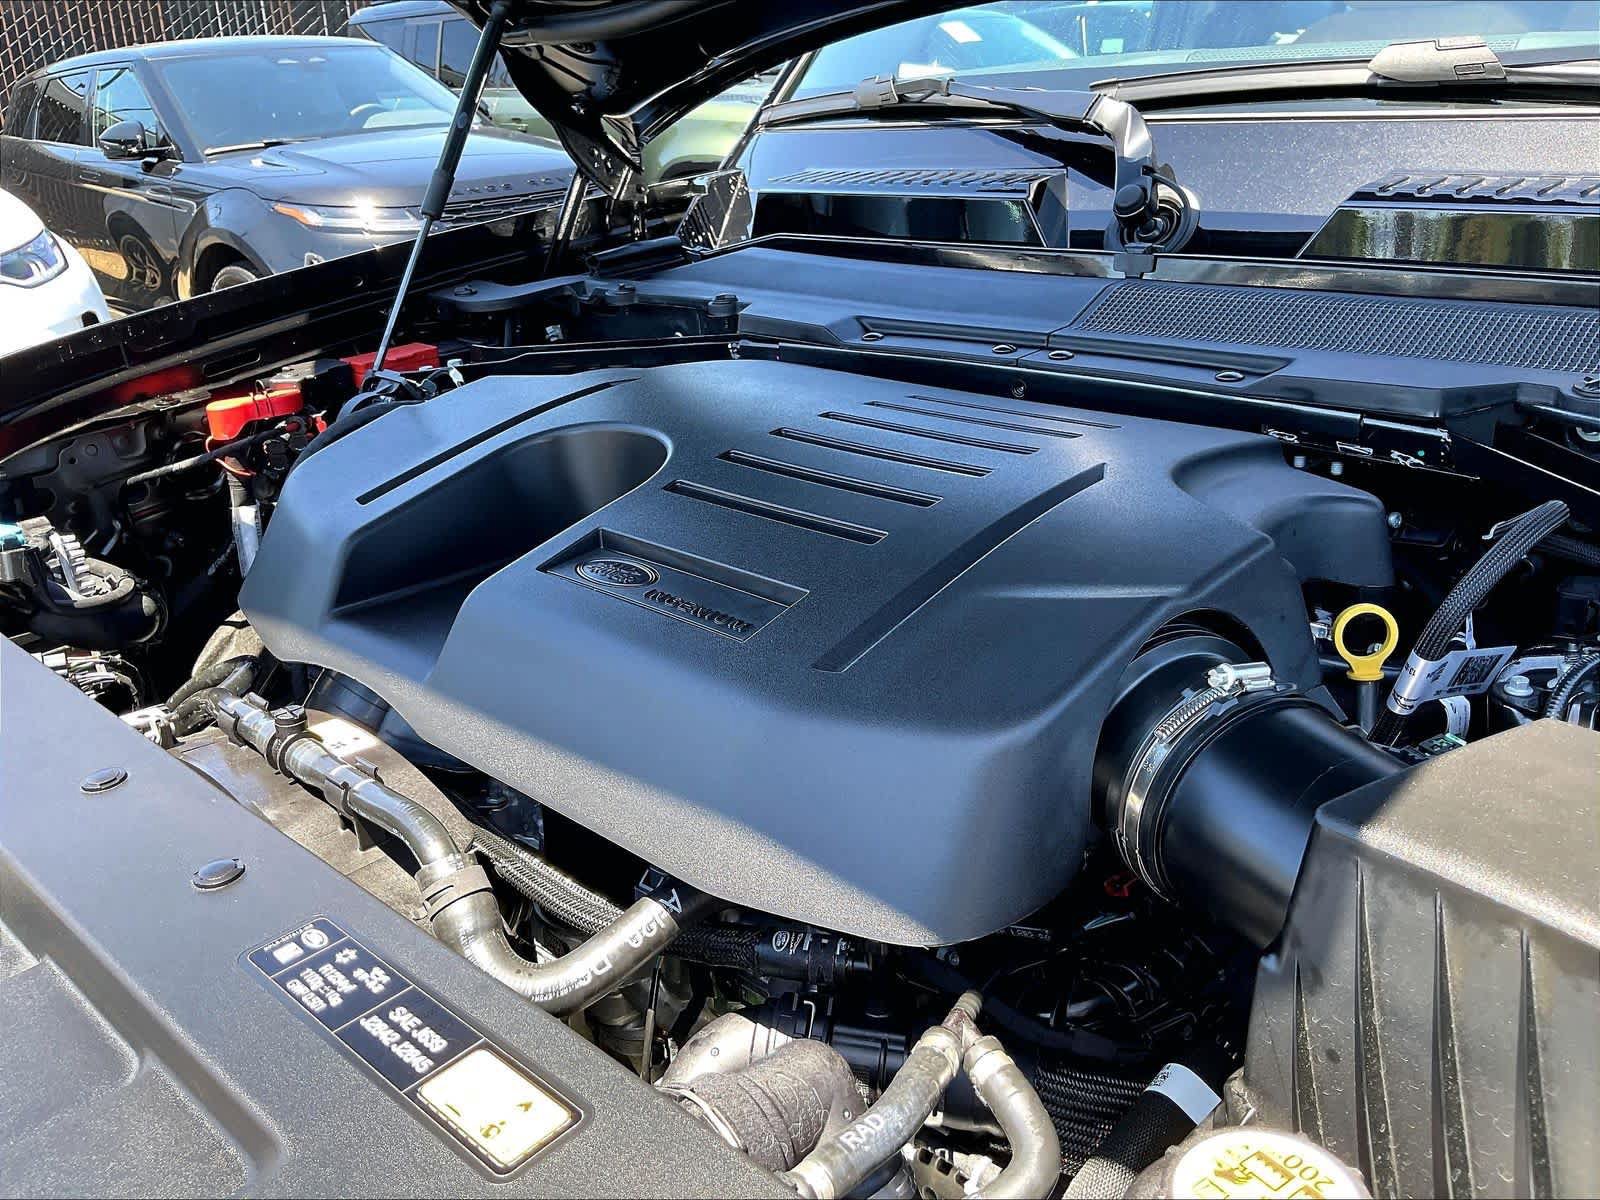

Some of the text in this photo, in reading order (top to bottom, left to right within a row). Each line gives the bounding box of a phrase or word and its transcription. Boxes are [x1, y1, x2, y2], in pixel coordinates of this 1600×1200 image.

[643, 588, 754, 633] INGENIUM
[388, 1006, 423, 1033] SAE
[390, 1041, 435, 1074] J2845
[839, 1113, 884, 1151] RAD
